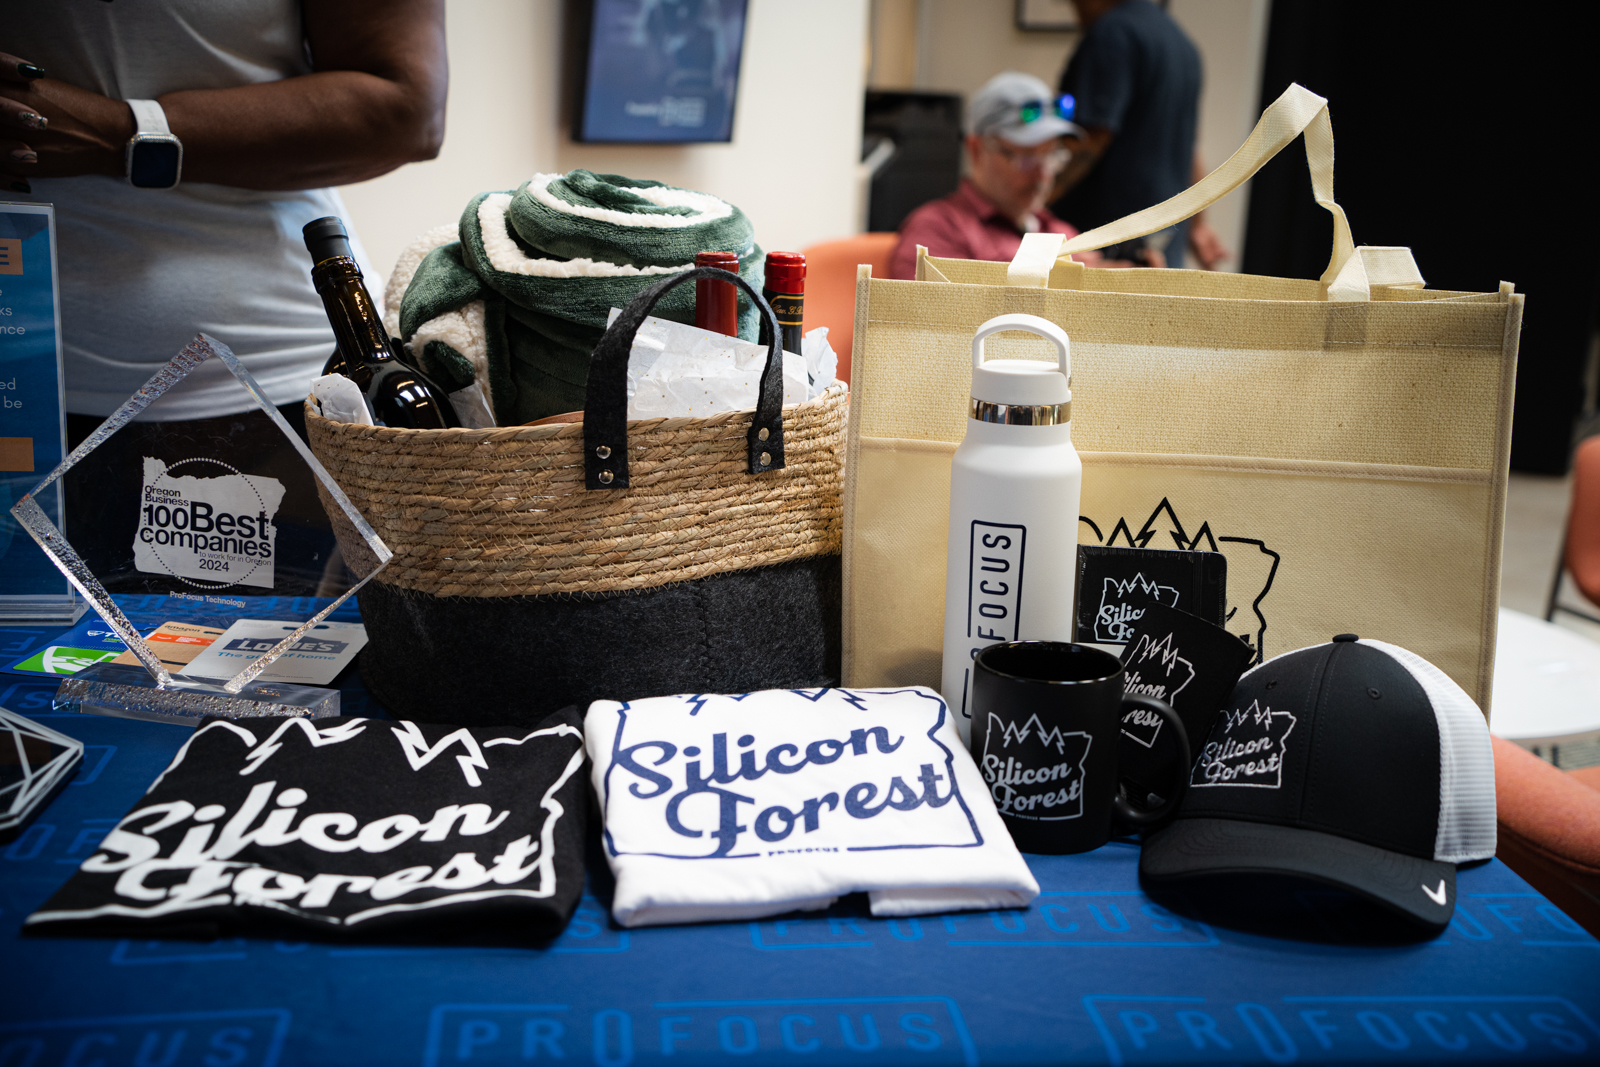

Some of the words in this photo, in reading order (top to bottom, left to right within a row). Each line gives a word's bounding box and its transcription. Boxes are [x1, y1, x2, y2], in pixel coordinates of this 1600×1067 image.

[4, 396, 22, 408] be
[144, 485, 181, 498] Oregon
[145, 494, 189, 506] Business
[140, 527, 272, 558] companies
[199, 558, 229, 572] 2024
[208, 552, 225, 560] work
[227, 553, 236, 562] for
[245, 556, 271, 566] Oregon
[169, 591, 203, 602] ProFocus
[205, 595, 246, 608] Technology
[970, 533, 1012, 661] FOCUS
[1100, 603, 1146, 626] Silic
[218, 651, 239, 659] The
[300, 652, 337, 660] home
[238, 639, 335, 652] LOE'S
[618, 725, 905, 799] Silicon
[1201, 737, 1273, 767] Silicon
[985, 754, 1072, 785] Silicon
[1204, 753, 1280, 783] Forest
[665, 763, 955, 857] Forest
[992, 779, 1082, 812] Forest
[80, 781, 510, 873] Silicon
[115, 834, 542, 909] Forest
[455, 1008, 945, 1067] PROFOCUS
[1115, 1001, 1590, 1064] PROFOCUS
